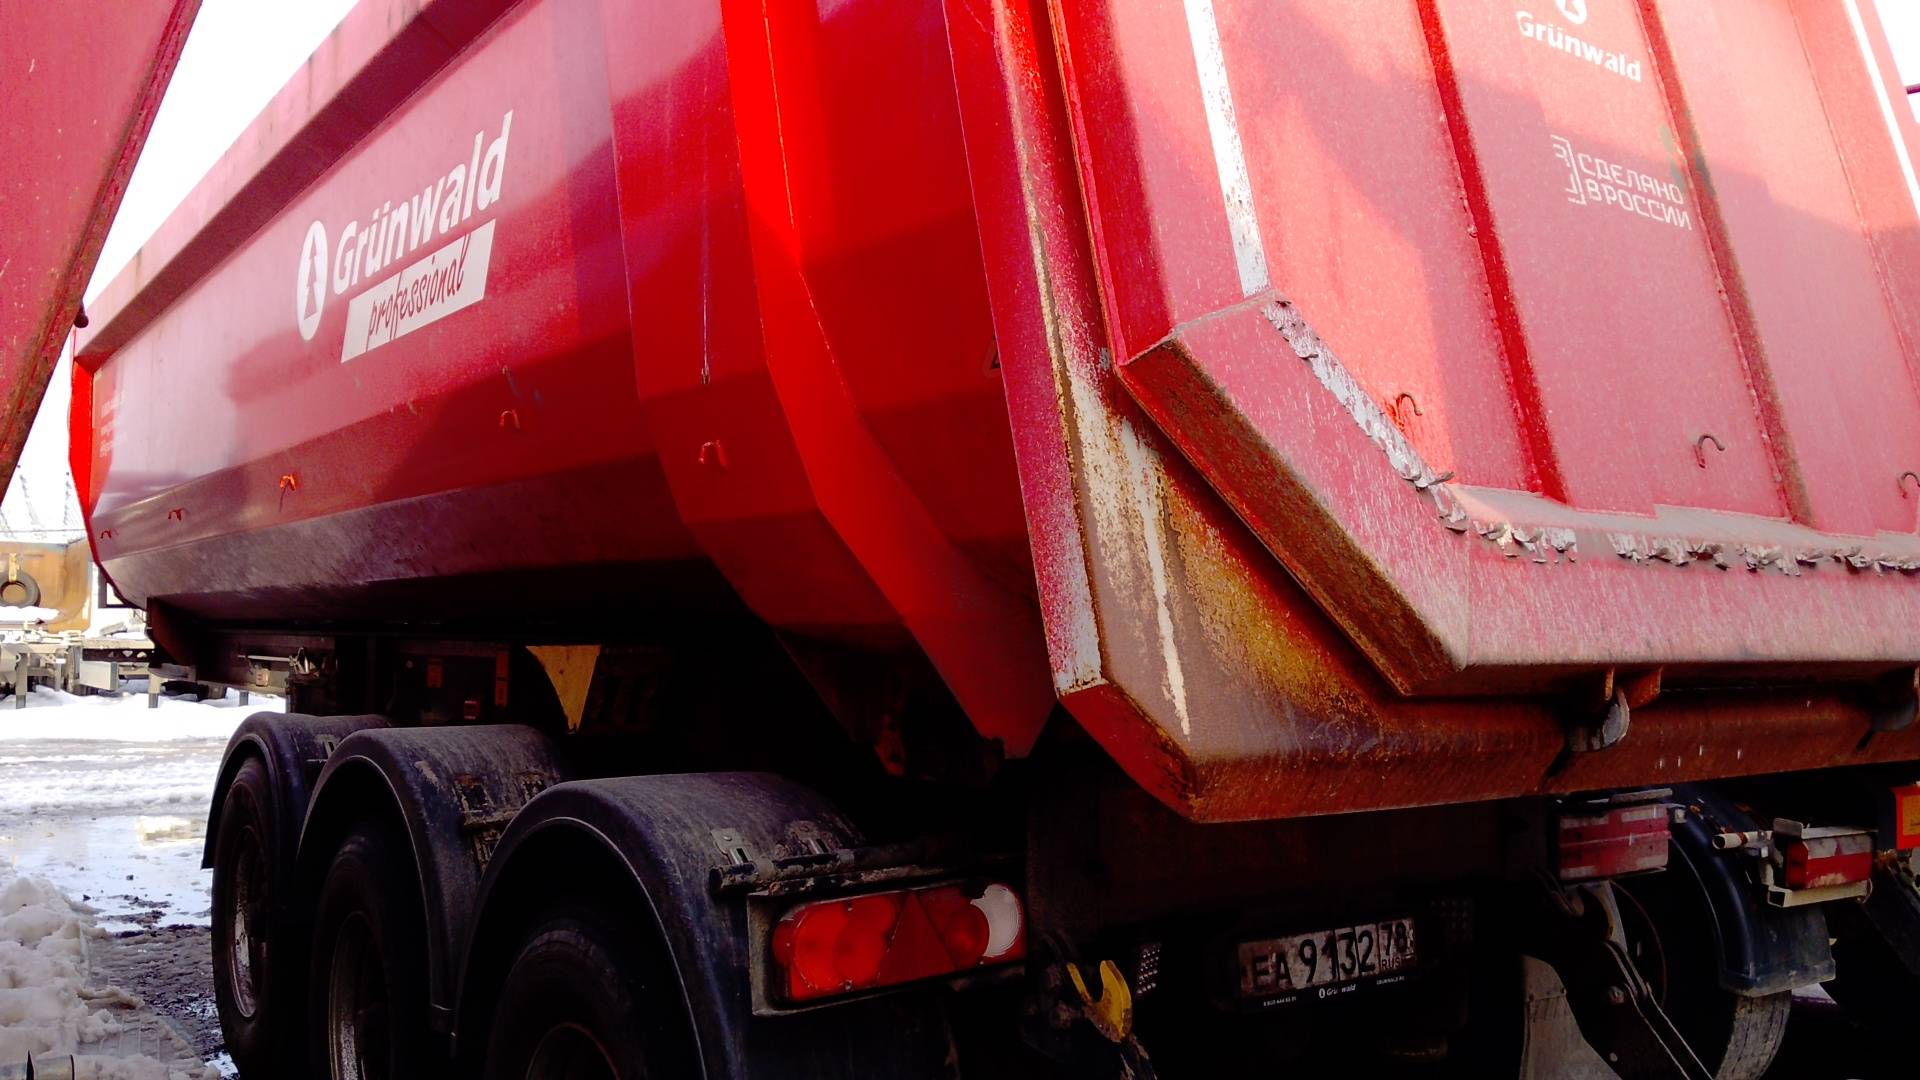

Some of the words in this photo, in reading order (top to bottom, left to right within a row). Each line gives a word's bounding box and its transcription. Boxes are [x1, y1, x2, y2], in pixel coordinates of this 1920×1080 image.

[1516, 10, 1642, 82] Grünwald
[333, 109, 513, 295] Grünwald
[1578, 152, 1684, 205] СДЕЛАНО
[366, 233, 471, 352] professional
[1381, 956, 1400, 971] RUS
